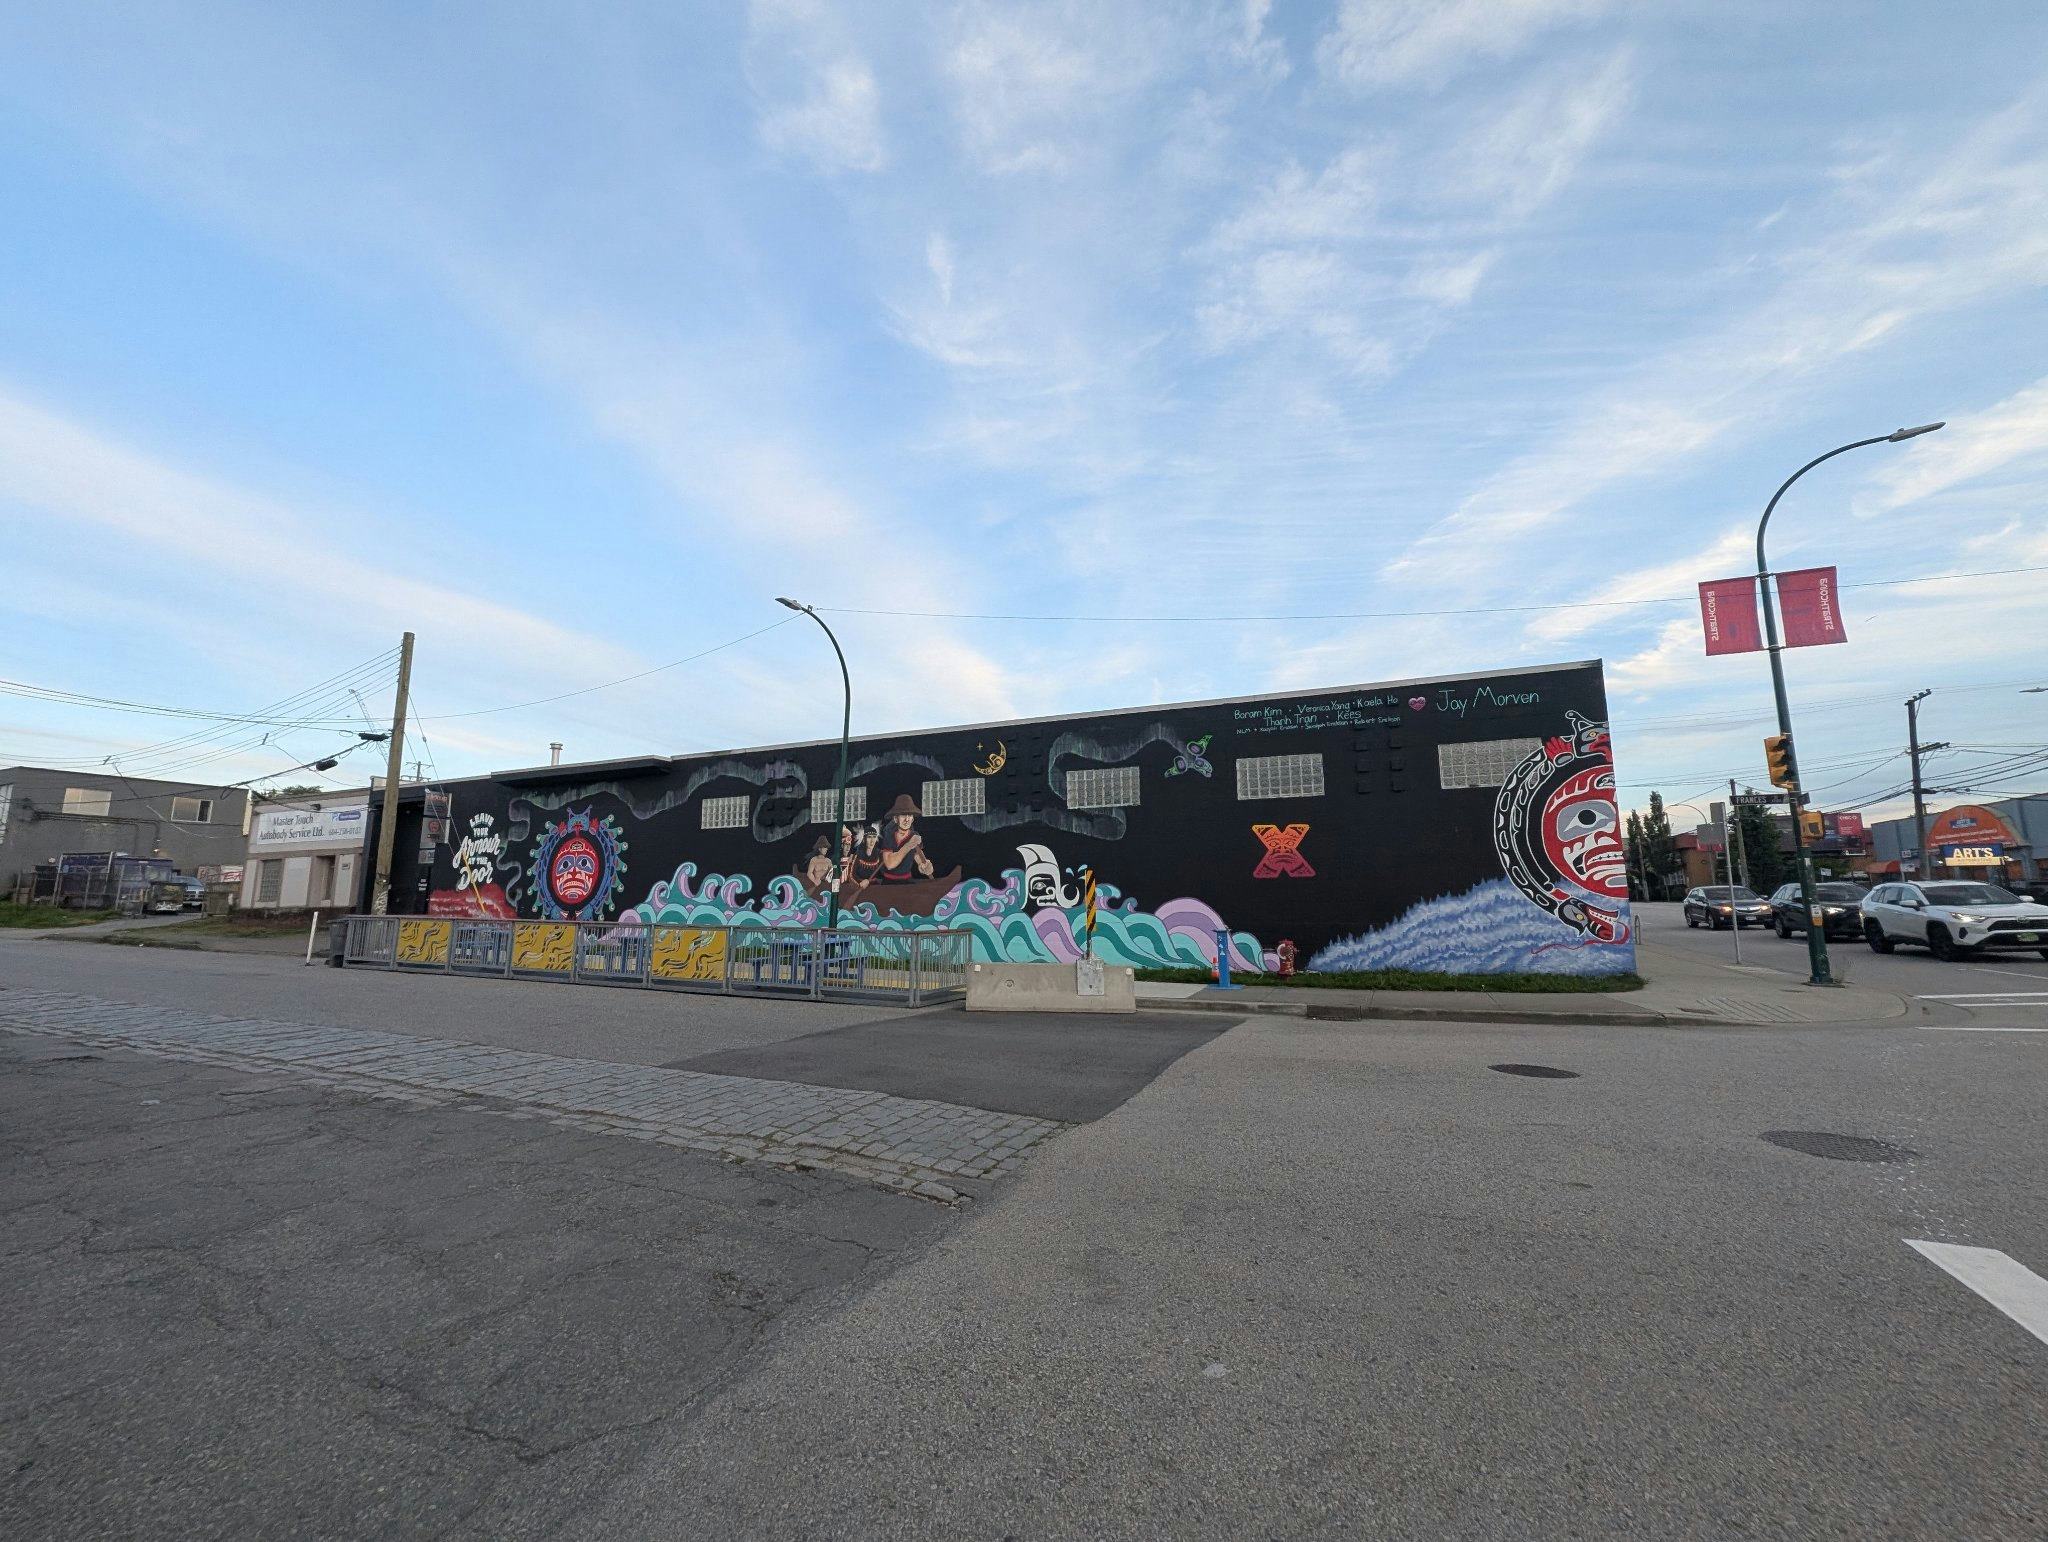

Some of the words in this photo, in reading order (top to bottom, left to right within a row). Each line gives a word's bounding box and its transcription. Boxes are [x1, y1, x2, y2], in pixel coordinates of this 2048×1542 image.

[1264, 706, 1283, 717] Kim
[1297, 704, 1331, 714] Veronica
[1331, 699, 1350, 712] Yang
[1357, 696, 1383, 708] Kaela
[1387, 695, 1399, 704] Ho
[1436, 689, 1468, 718] Jay
[1472, 686, 1540, 708] Morven
[1263, 715, 1292, 727] Thanh
[1294, 713, 1318, 724] Tran
[1735, 796, 1767, 804] FRANCES
[273, 816, 294, 826] Master
[295, 813, 313, 825] Touch
[469, 813, 495, 828] LEAVE
[260, 828, 287, 843] Autobody
[288, 827, 311, 839] Service
[312, 825, 325, 837] Ltd.
[473, 827, 489, 837] YOUR
[452, 833, 501, 869] Armour
[1953, 847, 1994, 858] ART'S
[468, 857, 475, 865] AT
[477, 857, 488, 865] THE
[457, 862, 494, 891] Door
